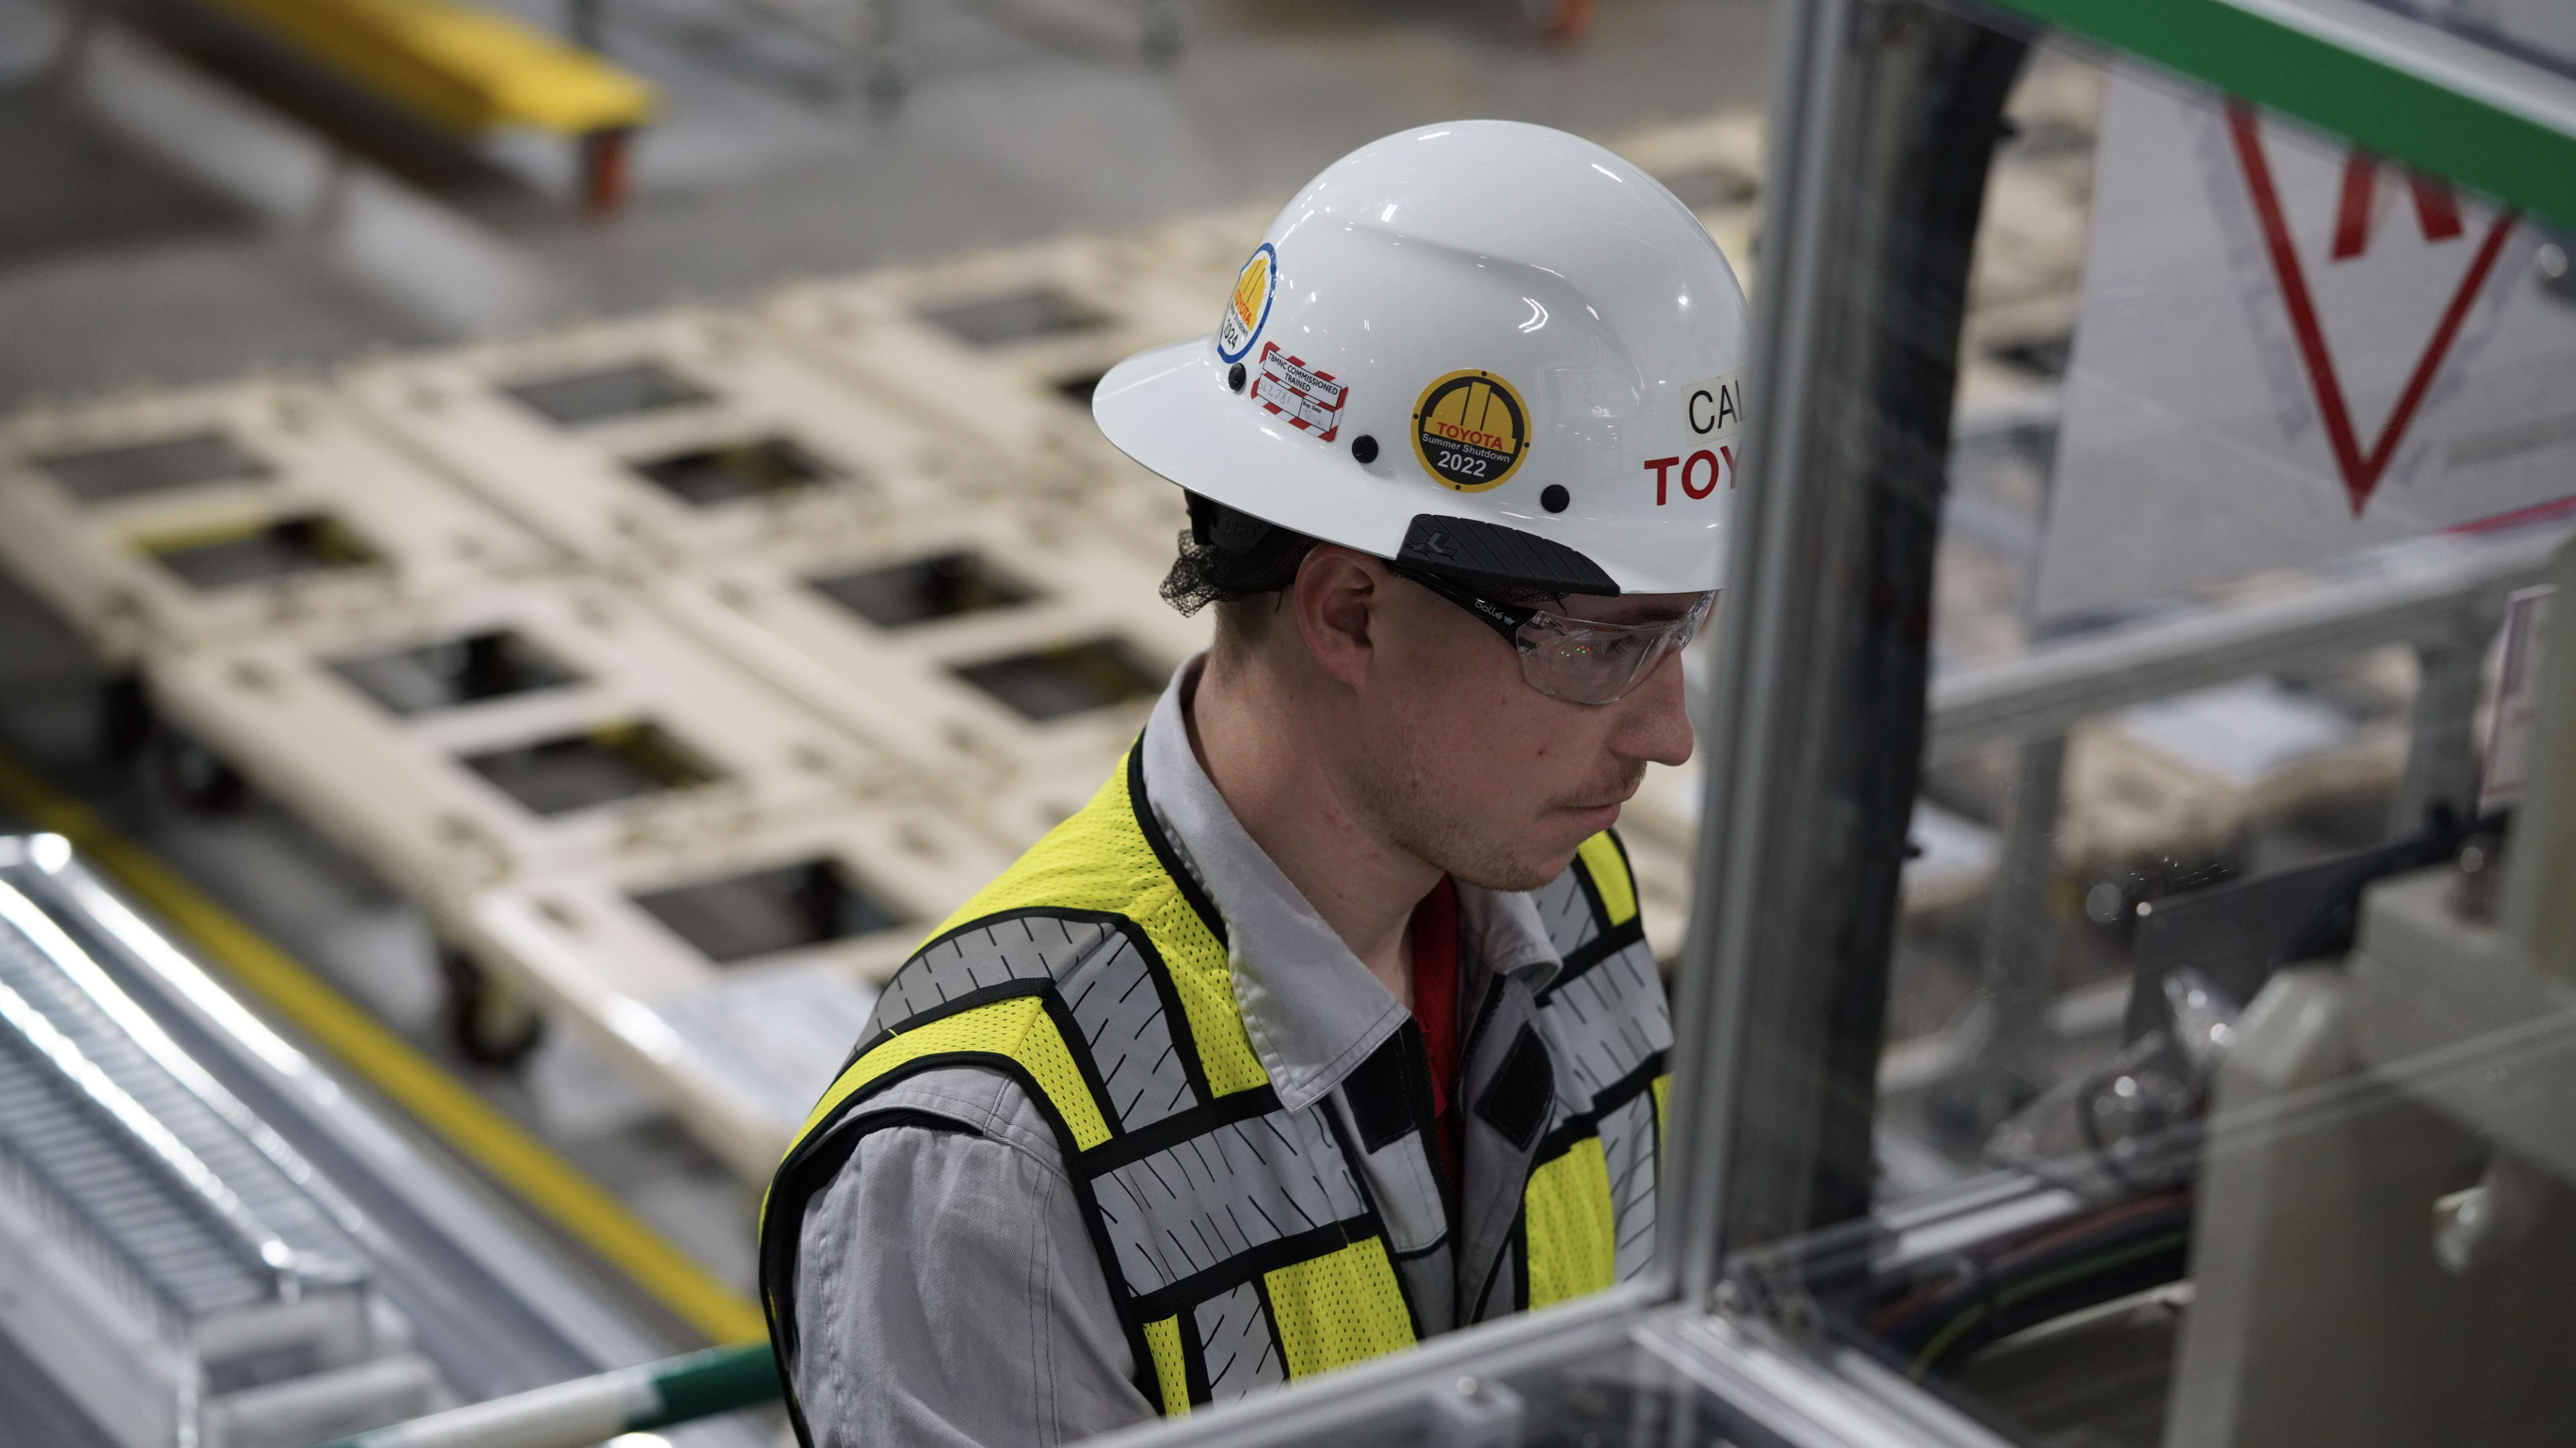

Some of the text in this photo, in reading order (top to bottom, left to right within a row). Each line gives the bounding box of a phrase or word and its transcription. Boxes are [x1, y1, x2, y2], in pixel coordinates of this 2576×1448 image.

[1224, 319, 1239, 349] 024
[1269, 352, 1338, 395] TBMNC COMMISSIONED
[1285, 373, 1311, 392] TRAINED
[1312, 404, 1322, 414] Date
[1422, 433, 1510, 463] Summer Shutdown
[1438, 422, 1503, 450] TOYOTA
[1437, 451, 1487, 477] 2022
